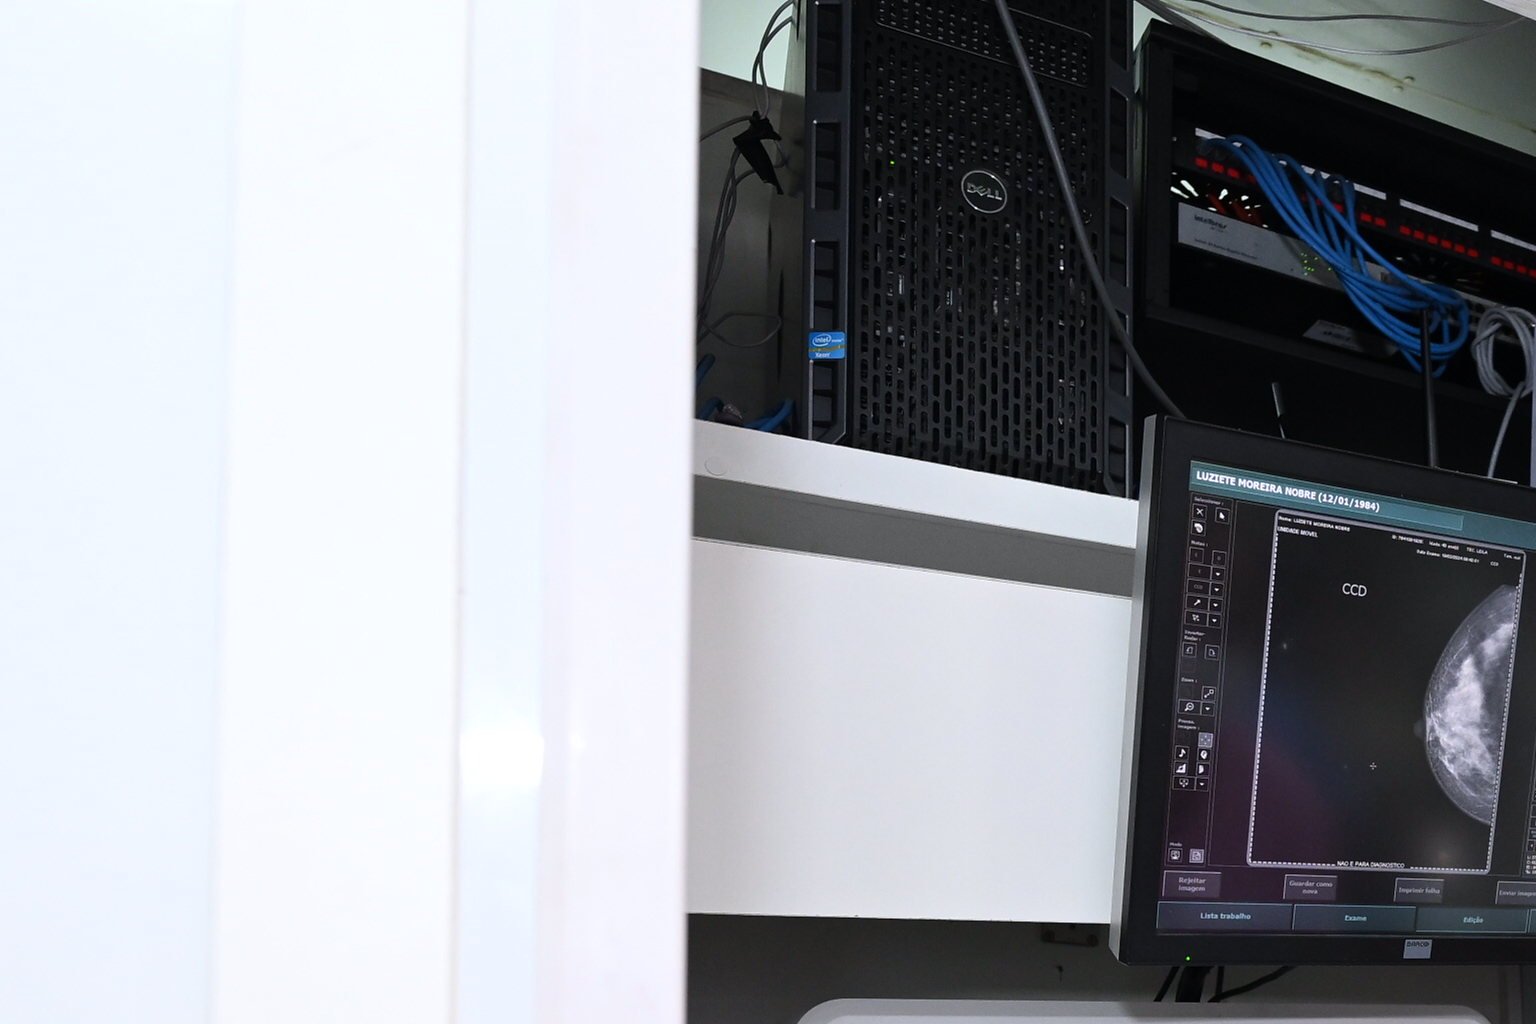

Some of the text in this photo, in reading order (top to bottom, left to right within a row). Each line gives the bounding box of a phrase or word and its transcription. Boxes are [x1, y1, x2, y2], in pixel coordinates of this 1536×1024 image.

[967, 182, 1002, 200] DELL
[1197, 471, 1380, 513] LUZIETE MOREIRA NOBRE (12/01/1984)
[1342, 583, 1367, 597] CCD
[1179, 877, 1206, 886] Rejeitar
[1289, 880, 1315, 888] Guardar
[1399, 888, 1424, 896] Imprimir
[1200, 912, 1252, 921] Lista trabalho
[1464, 916, 1484, 925] Edição
